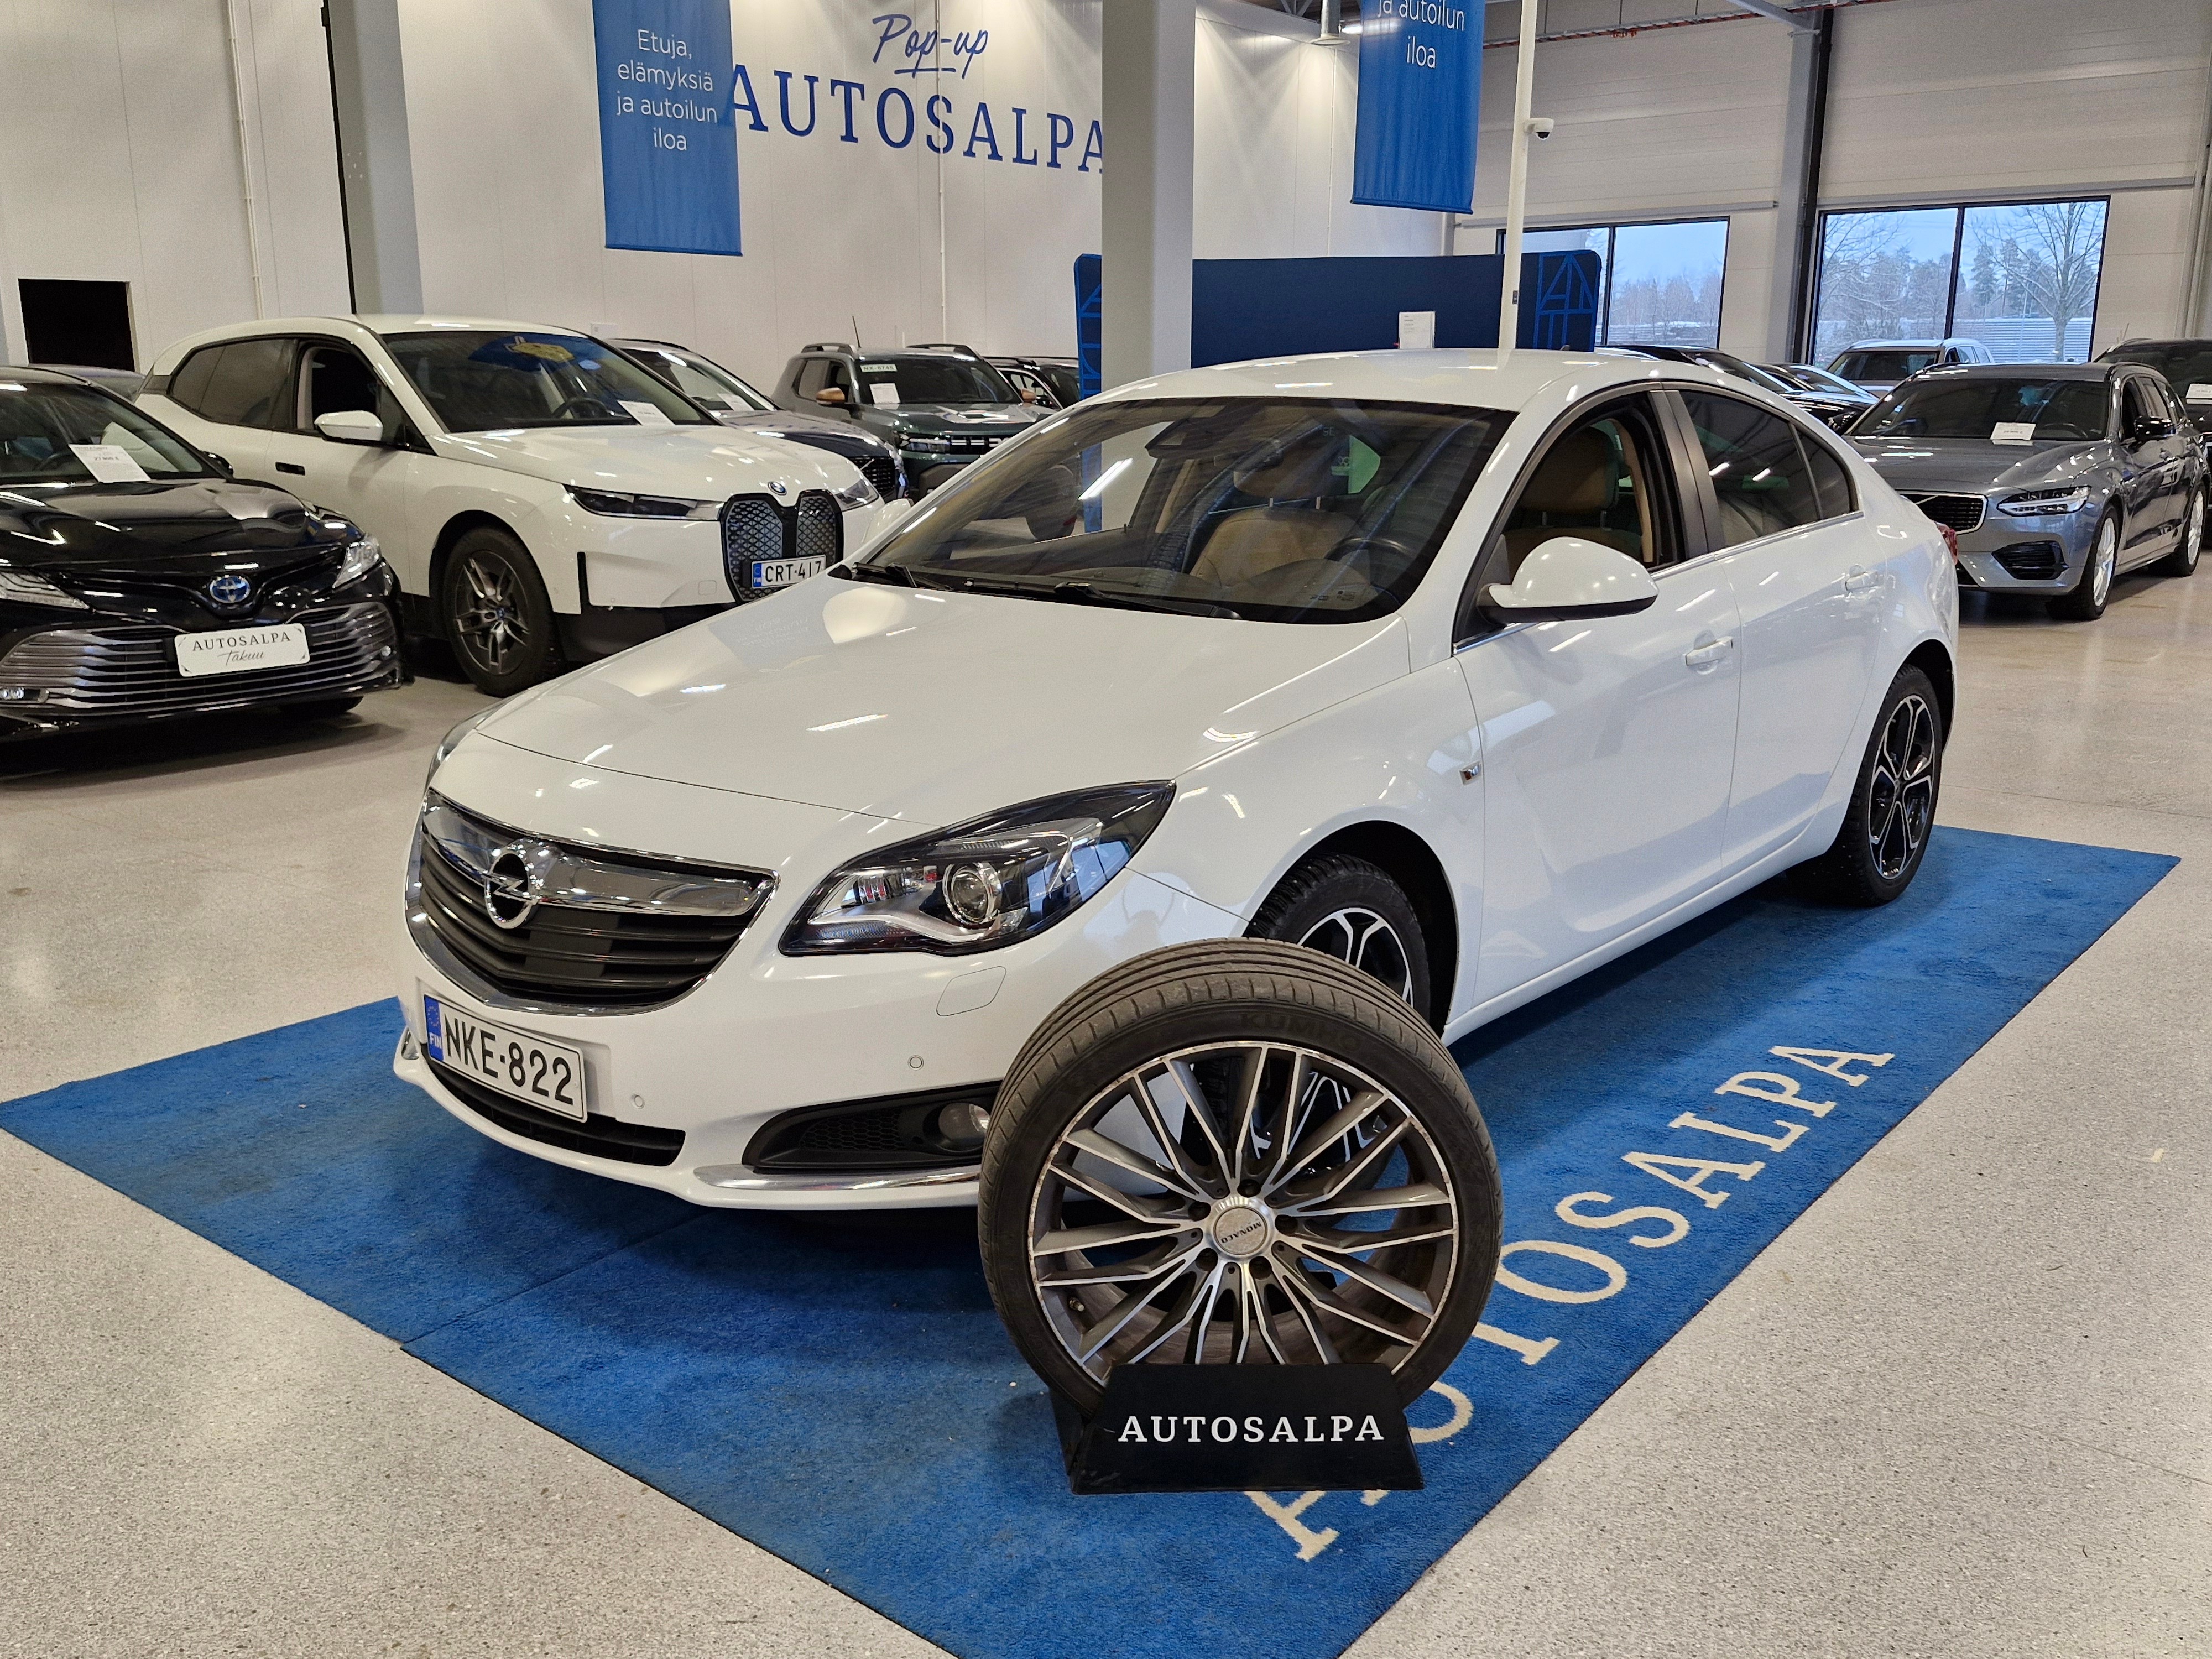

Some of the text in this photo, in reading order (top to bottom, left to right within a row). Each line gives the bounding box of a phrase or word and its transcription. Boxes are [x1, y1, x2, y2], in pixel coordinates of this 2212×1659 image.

[1377, 0, 1465, 32] ja autoilun
[637, 29, 692, 60] Etuja,
[872, 13, 988, 80] Pop-up
[1406, 35, 1436, 69] iloa
[617, 59, 713, 92] elämyksiä
[616, 90, 717, 123] ja autoilun
[732, 64, 1103, 174] AUTOSALPA
[653, 127, 687, 151] iloa
[765, 560, 822, 582] CRT-417
[192, 631, 291, 651] AUTOSALPA
[217, 649, 265, 666] Takuu
[429, 1031, 442, 1049] FIN
[444, 1013, 573, 1105] NKE-822
[1220, 1221, 1262, 1244] MONACO
[1117, 1415, 1385, 1443] AUTOSALPA
